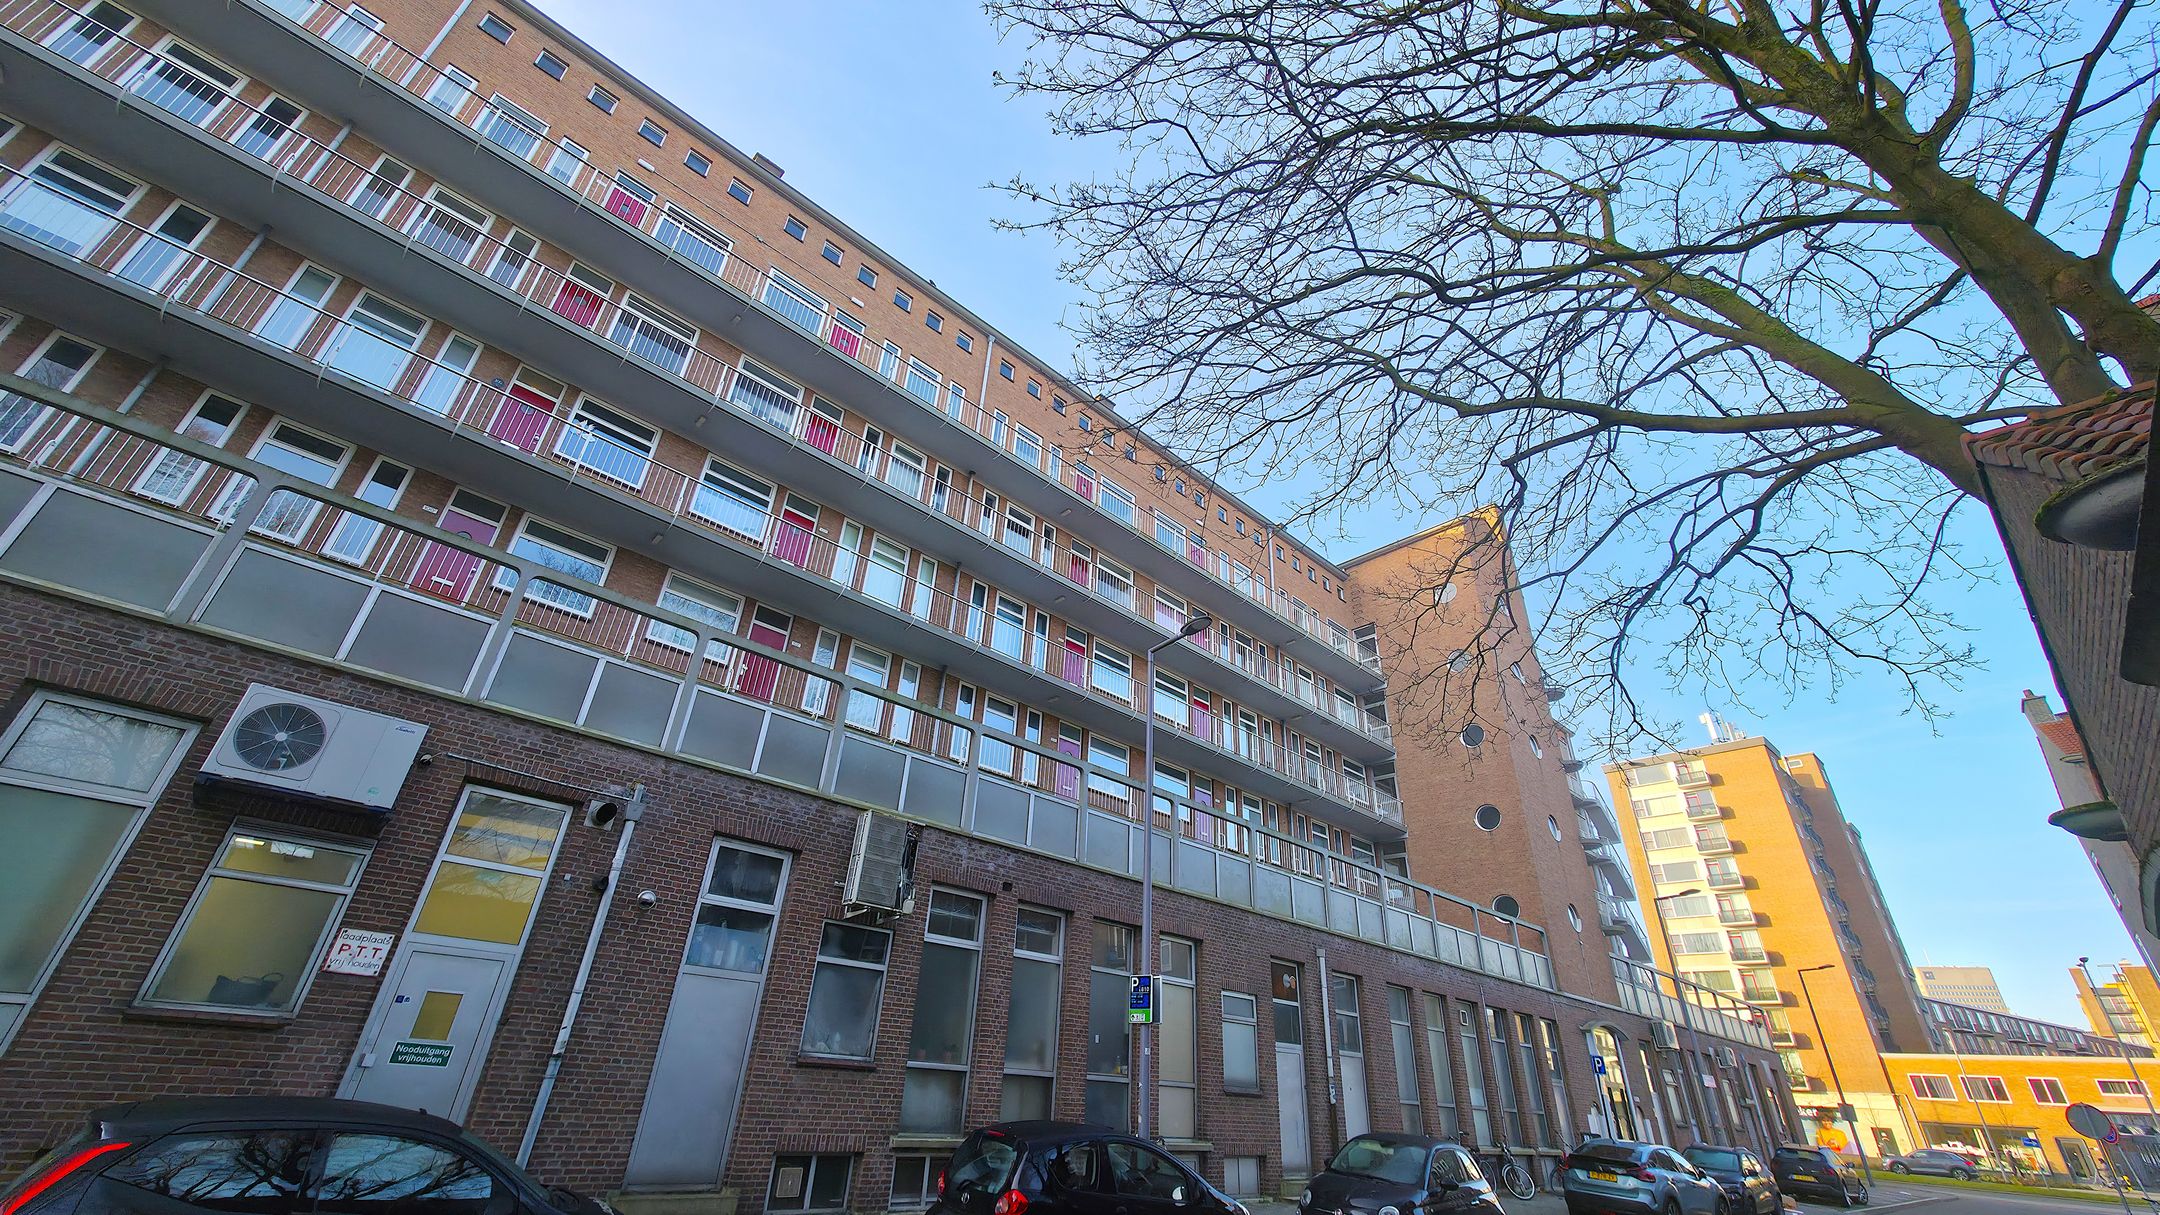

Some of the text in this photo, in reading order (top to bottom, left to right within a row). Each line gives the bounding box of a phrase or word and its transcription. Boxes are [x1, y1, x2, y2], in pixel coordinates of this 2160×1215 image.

[340, 931, 391, 945] laadplaats
[338, 943, 383, 959] P.T.T.
[1131, 977, 1139, 992] P
[396, 1044, 450, 1057] Nooduitgang
[398, 1054, 442, 1064] vrijhouden
[1595, 1057, 1602, 1072] P
[1798, 1106, 1818, 1117] ker
